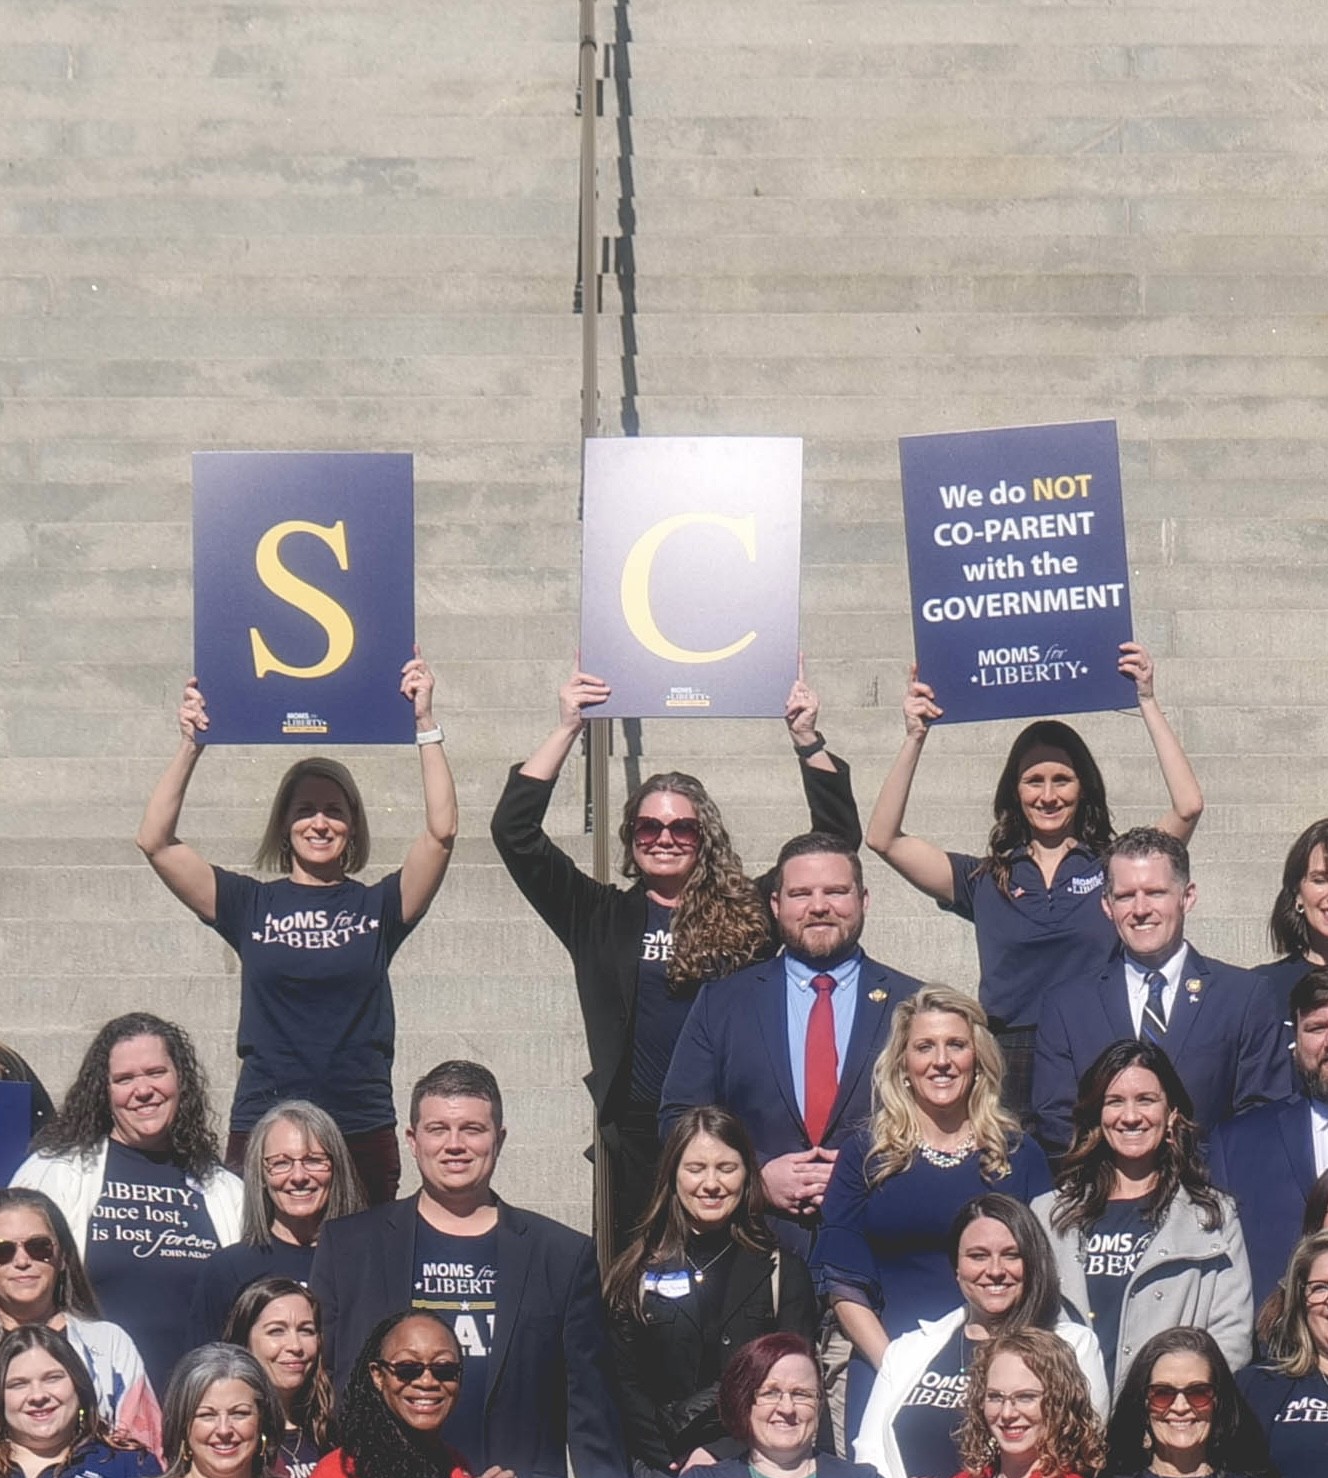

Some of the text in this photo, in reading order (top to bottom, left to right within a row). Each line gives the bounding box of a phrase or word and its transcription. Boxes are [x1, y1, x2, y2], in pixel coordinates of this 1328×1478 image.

[940, 475, 1093, 509] We do NOT
[934, 511, 1094, 547] CO-PARENT
[962, 551, 1079, 582] with the
[249, 519, 355, 678] S
[620, 512, 757, 663] C
[922, 583, 1124, 622] GOVERNMENT
[978, 644, 1069, 666] MOMS for
[981, 661, 1080, 686] LIBERTY
[263, 915, 367, 949] LIBERTY
[264, 910, 357, 932] MOMS for
[92, 1204, 189, 1230] once lost,
[92, 1224, 111, 1241] is
[115, 1224, 153, 1243] lost
[1087, 1233, 1133, 1253] OMS
[159, 1249, 185, 1259] JOHN
[423, 1262, 498, 1281] MOMS for
[424, 1278, 496, 1294] LIBERT
[922, 1371, 971, 1391] OMS
[904, 1387, 969, 1409] IBER
